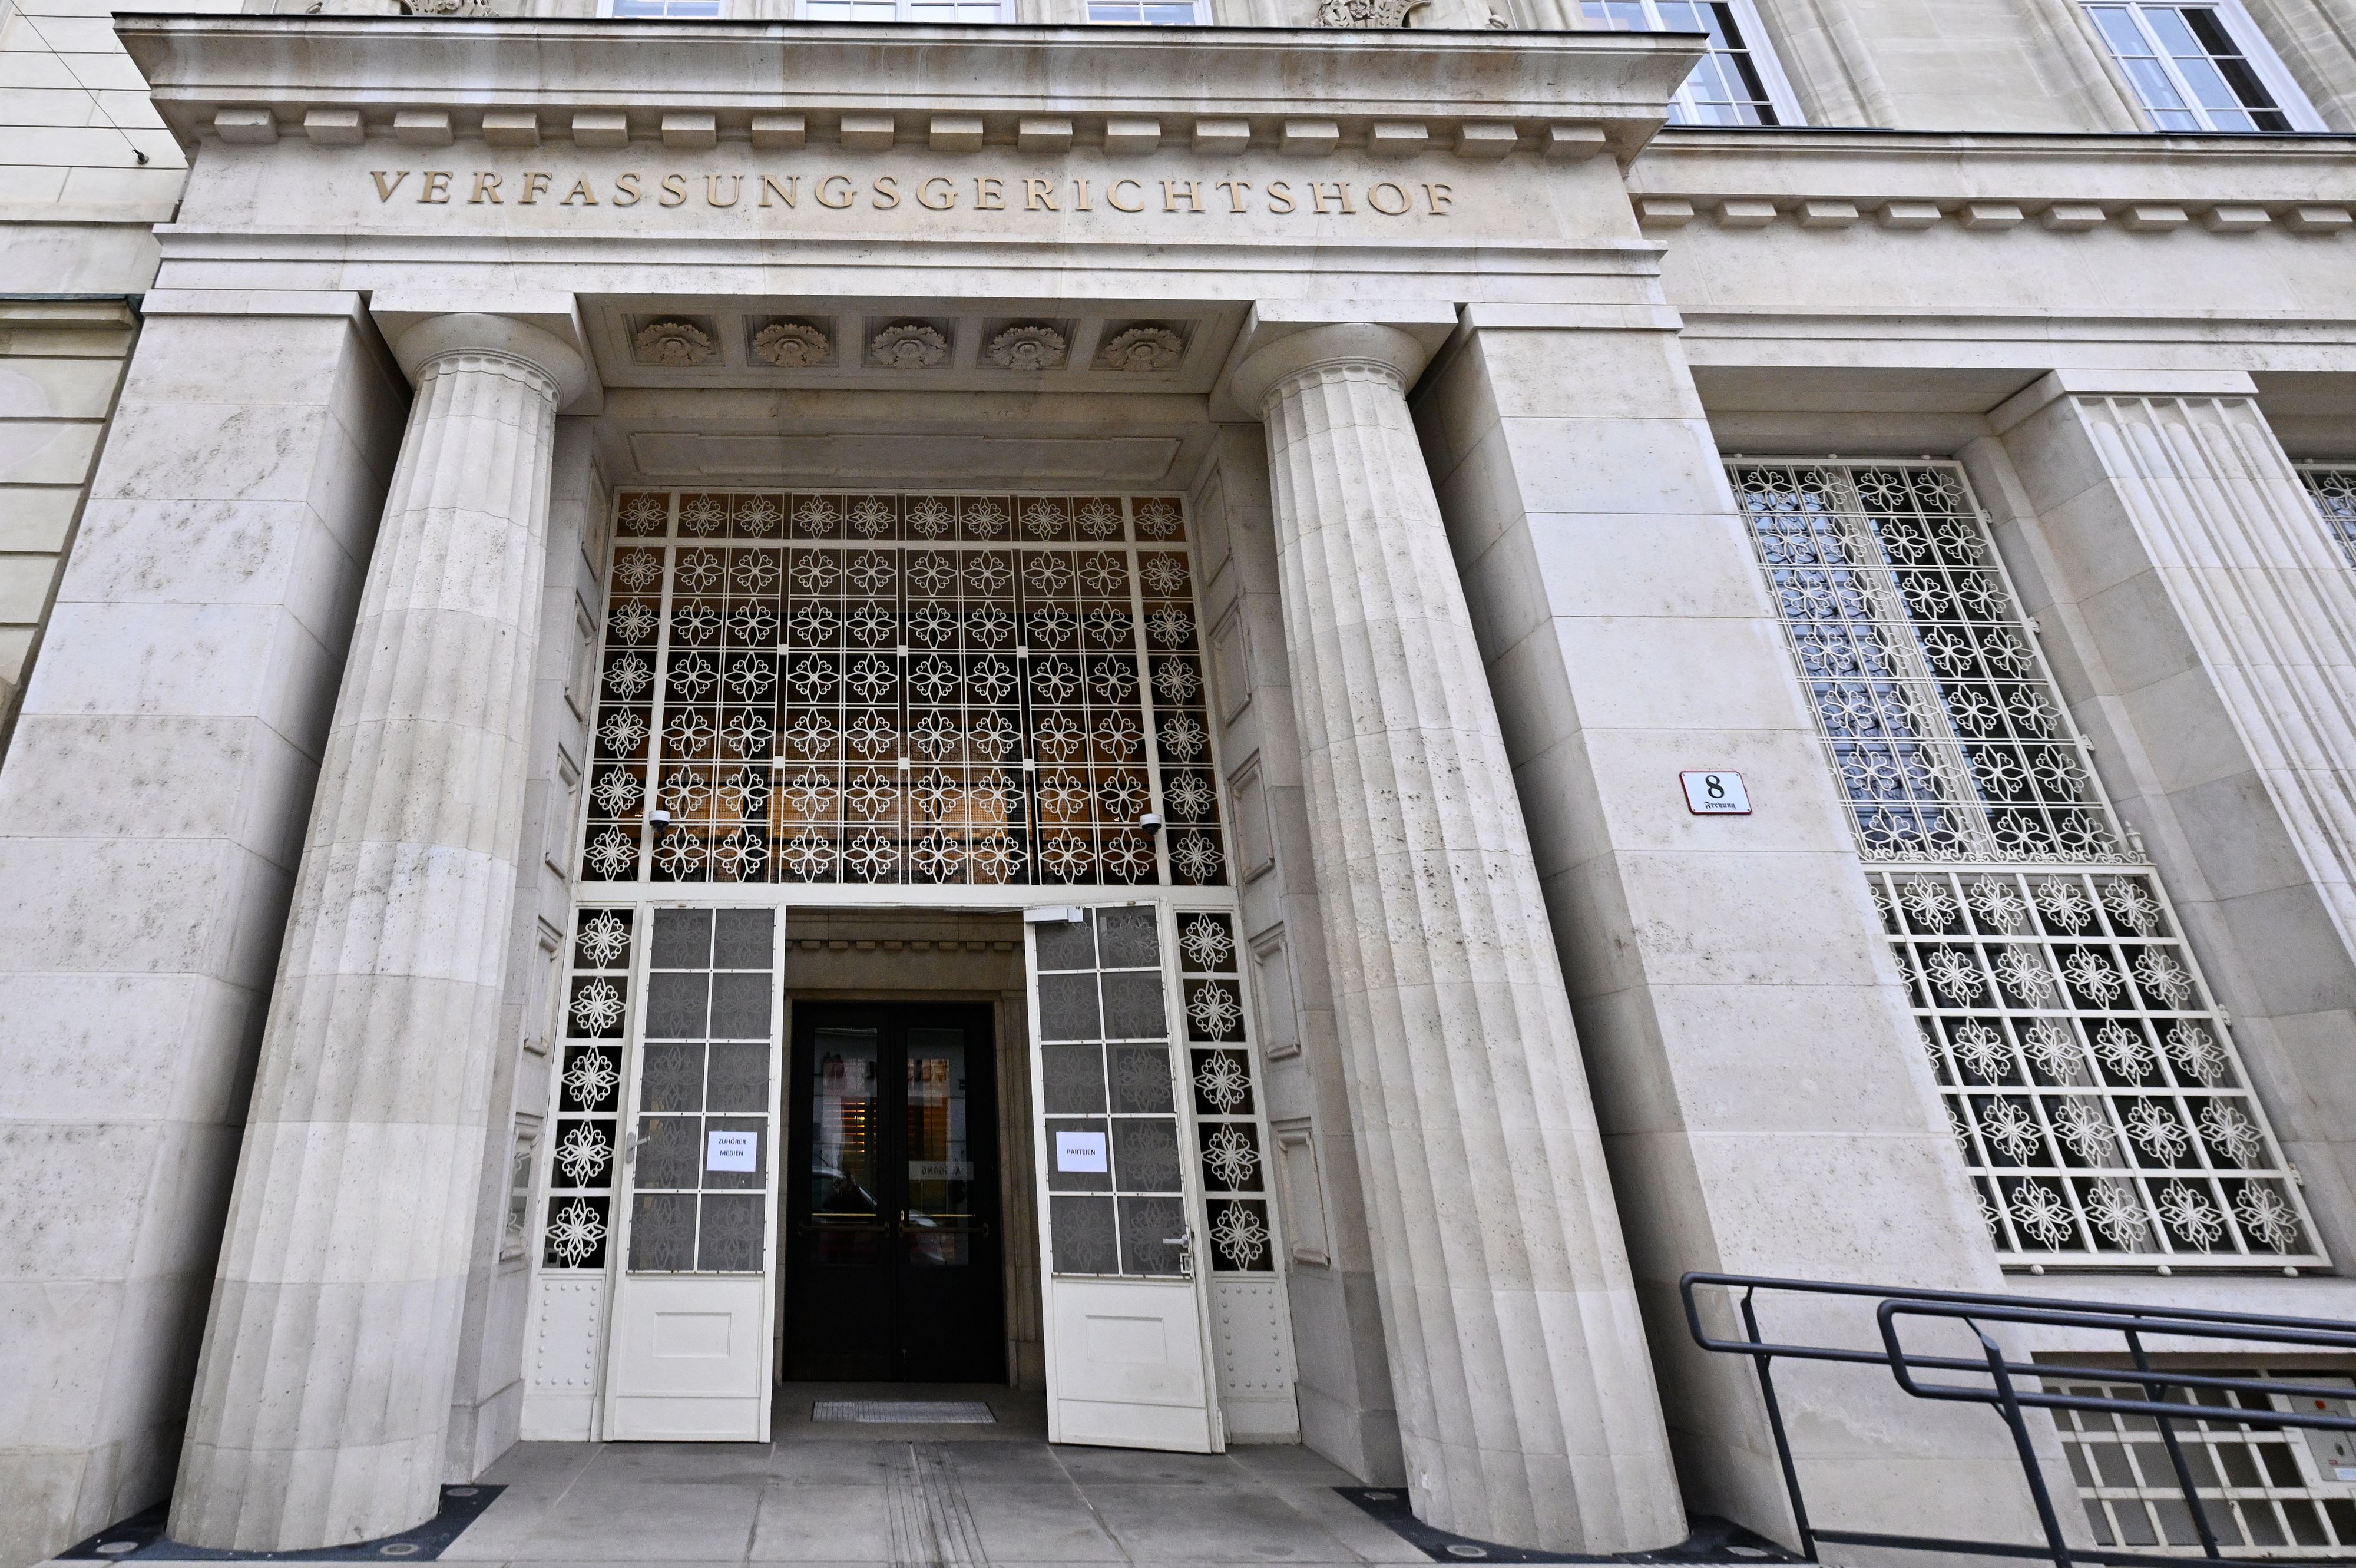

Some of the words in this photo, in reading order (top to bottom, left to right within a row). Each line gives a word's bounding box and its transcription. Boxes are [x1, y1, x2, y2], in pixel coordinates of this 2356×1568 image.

[370, 170, 1454, 215] VERFASSUNGSGERICHTSHOF
[1705, 775, 1724, 798] 8
[1704, 801, 1736, 810] Freyung
